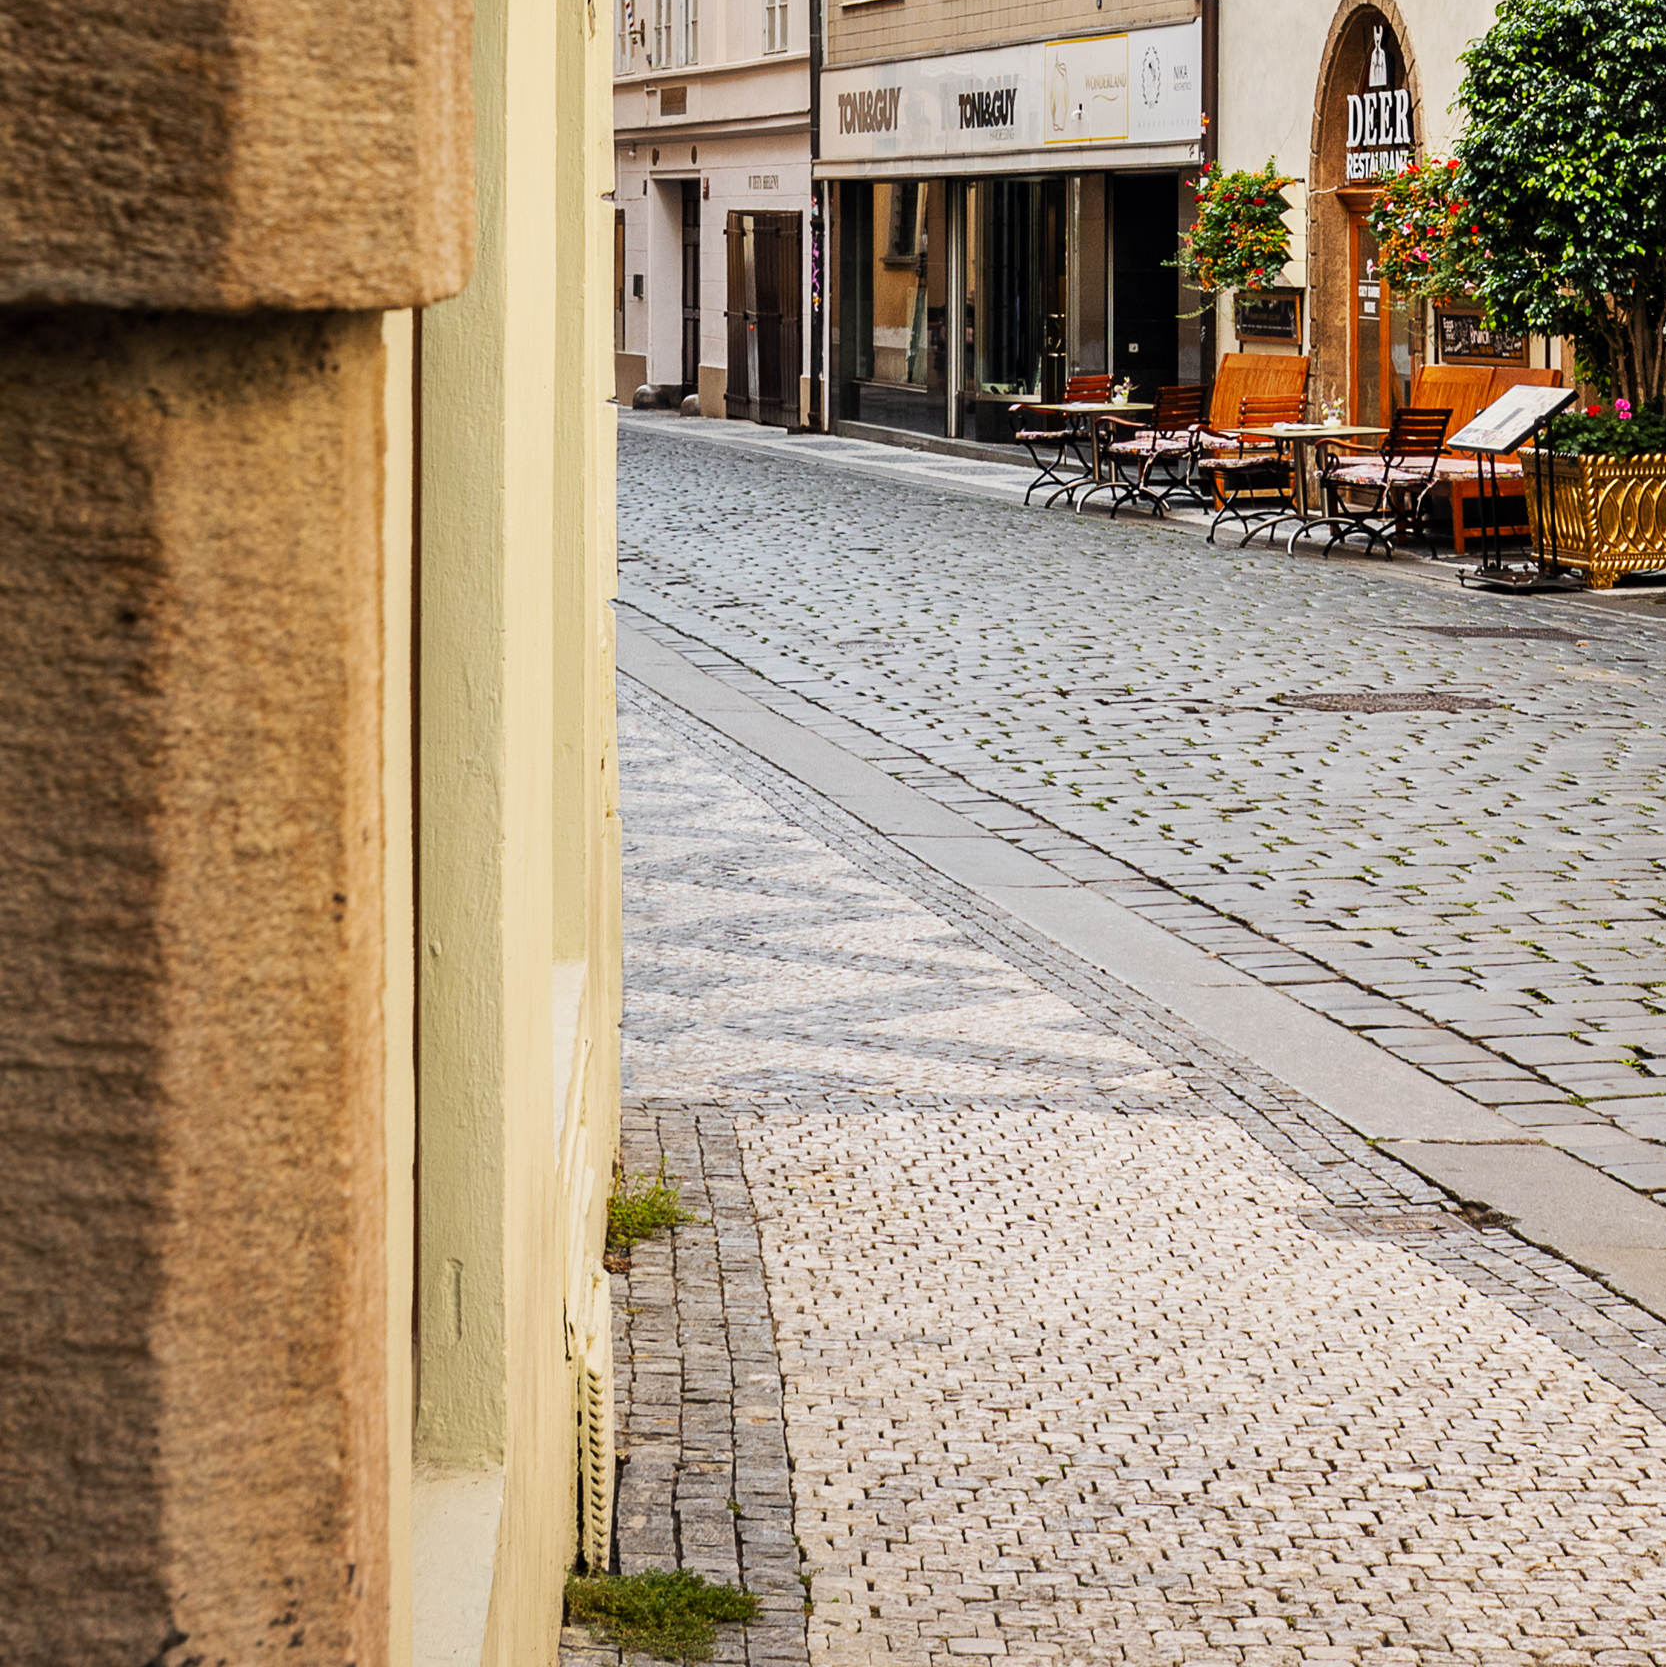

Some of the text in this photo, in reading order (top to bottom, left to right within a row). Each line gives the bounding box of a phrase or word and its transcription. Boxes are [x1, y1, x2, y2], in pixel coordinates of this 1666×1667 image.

[1084, 72, 1127, 90] WONDERLAND
[838, 86, 902, 134] TONI&GUY
[958, 88, 1018, 130] TONI&GUY
[1346, 88, 1411, 147] DEER
[1346, 149, 1409, 179] RESTAURANT
